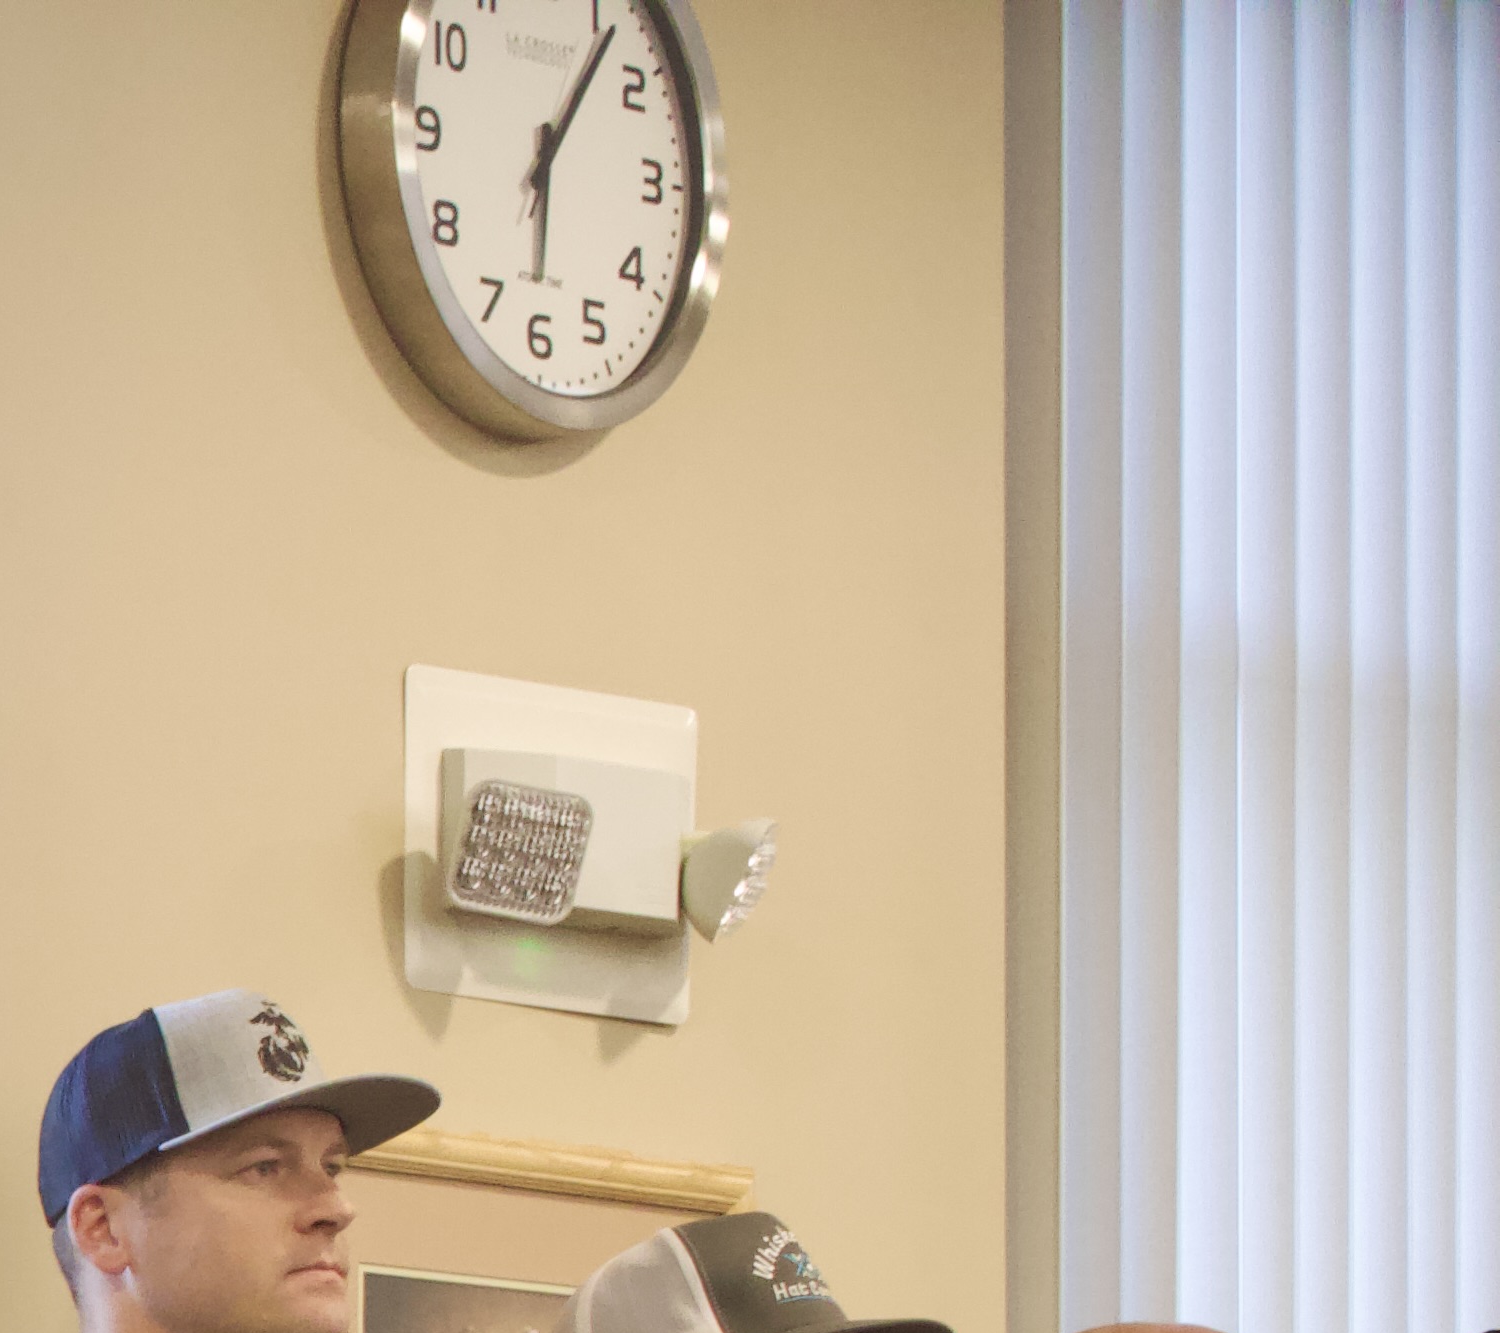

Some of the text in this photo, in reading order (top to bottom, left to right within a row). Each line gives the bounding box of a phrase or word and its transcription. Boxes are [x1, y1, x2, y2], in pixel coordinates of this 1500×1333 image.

[434, 21, 468, 72] 10
[621, 64, 646, 113] 2
[415, 105, 442, 152] 9
[641, 157, 663, 206] 3
[432, 200, 460, 247] 8
[618, 246, 645, 291] 4
[479, 276, 505, 323] 7
[582, 298, 606, 346] 5
[527, 314, 553, 360] 6
